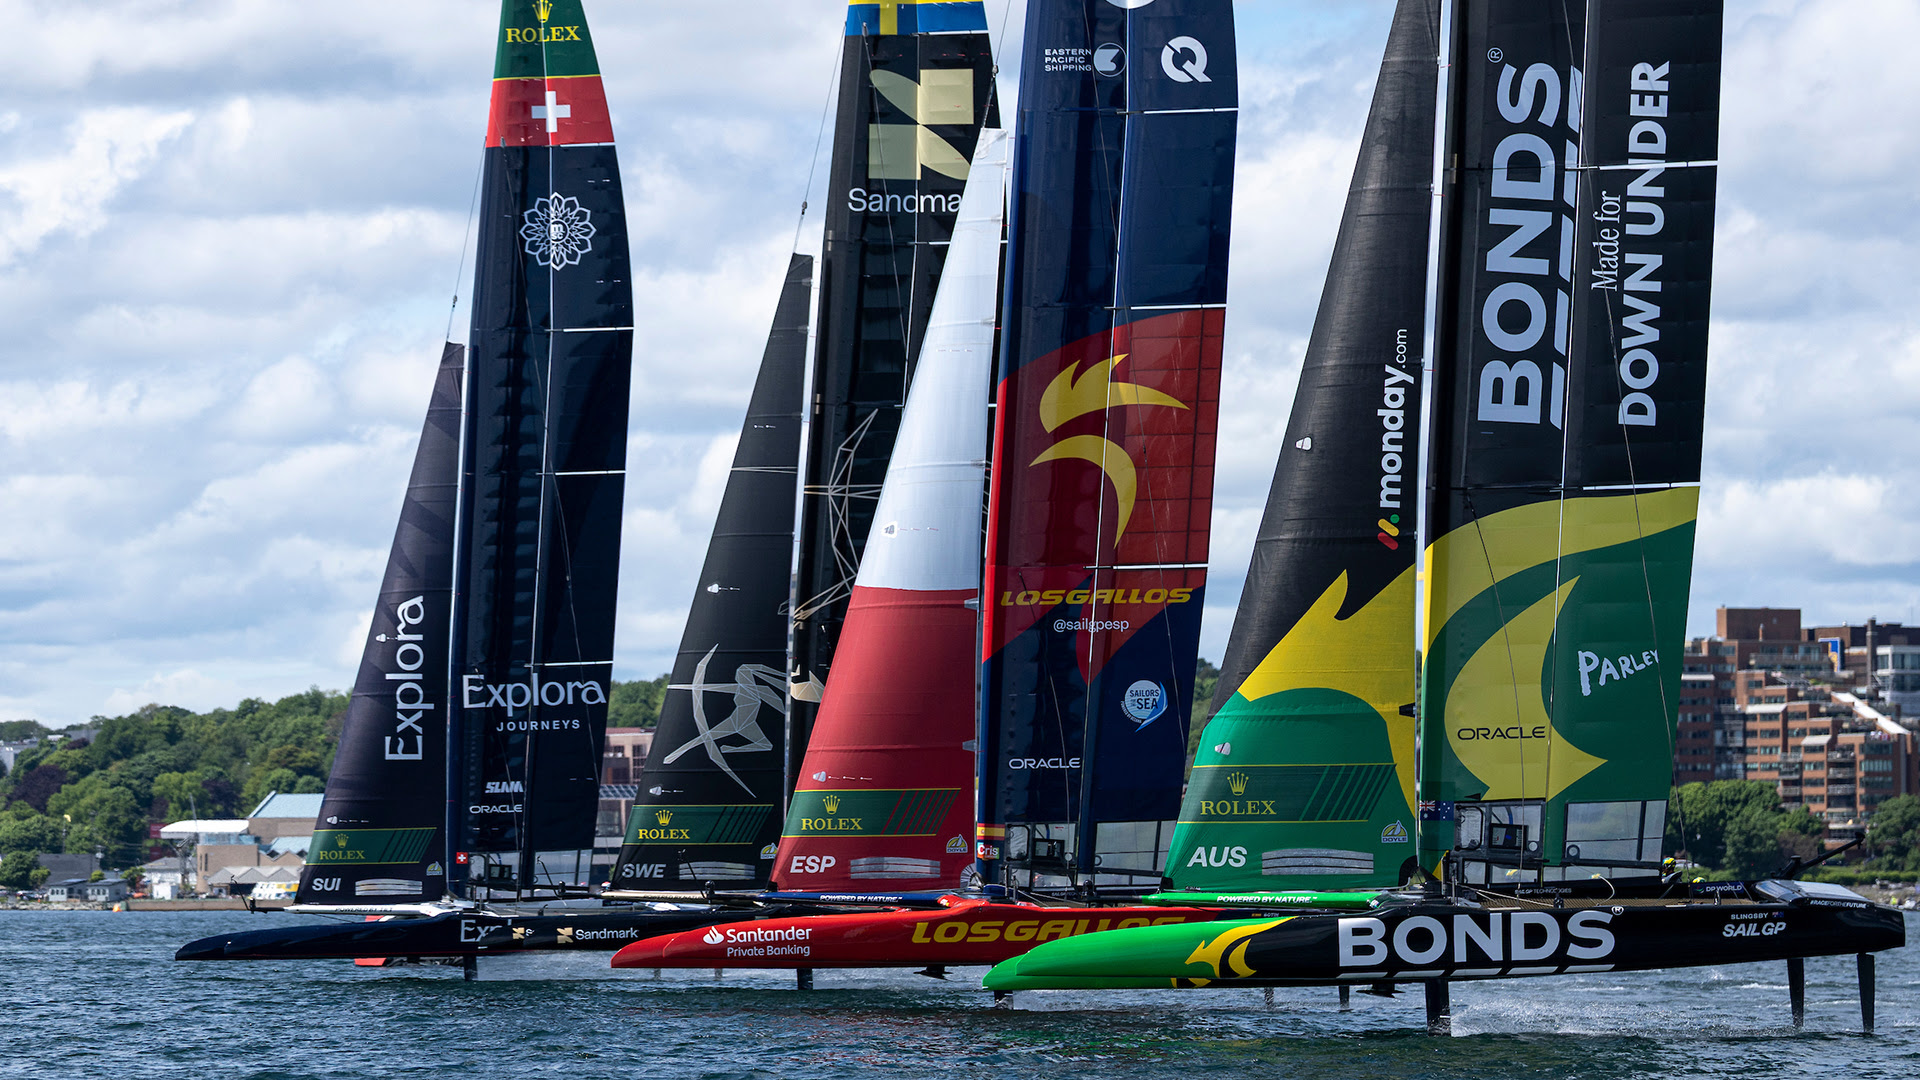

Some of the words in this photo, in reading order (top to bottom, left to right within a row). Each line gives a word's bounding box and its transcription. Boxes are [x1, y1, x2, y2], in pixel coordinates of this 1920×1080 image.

[505, 26, 581, 43] ROLEX
[1044, 48, 1092, 56] EASTERN
[1044, 56, 1086, 64] PACIFIC
[1044, 64, 1092, 72] SHIPPING
[1625, 60, 1670, 237] UNDER
[848, 187, 962, 213] Sandma
[1591, 190, 1621, 222] for
[1591, 226, 1619, 292] Made
[1617, 253, 1663, 427] DOWN
[1377, 328, 1414, 508] monday.com
[1000, 587, 1193, 607] LOSGALLOS
[1053, 618, 1130, 633] @sailgpesp
[385, 595, 434, 760] Explora
[462, 672, 607, 717] Explora
[1129, 689, 1160, 698] SAILORS
[1136, 698, 1158, 710] SEA
[496, 719, 581, 732] JOURNEYS
[1457, 725, 1546, 740] ORACLE
[1008, 757, 1081, 769] ORACLE
[485, 781, 524, 793] SLAM
[469, 804, 523, 814] ORACLE
[1200, 800, 1277, 815] ROLEX
[801, 817, 863, 831] ROLEX
[638, 828, 691, 840] ROLEX
[319, 850, 366, 860] ROLEX
[1187, 846, 1248, 868] AUS
[621, 863, 667, 879] SWE
[789, 855, 837, 874] ESP
[312, 877, 342, 891] SUI
[1730, 912, 1769, 920] SLINGSBY
[575, 927, 639, 940] Sandmark
[726, 926, 813, 943] Santander
[727, 946, 765, 957] Private
[766, 945, 810, 957] Banking
